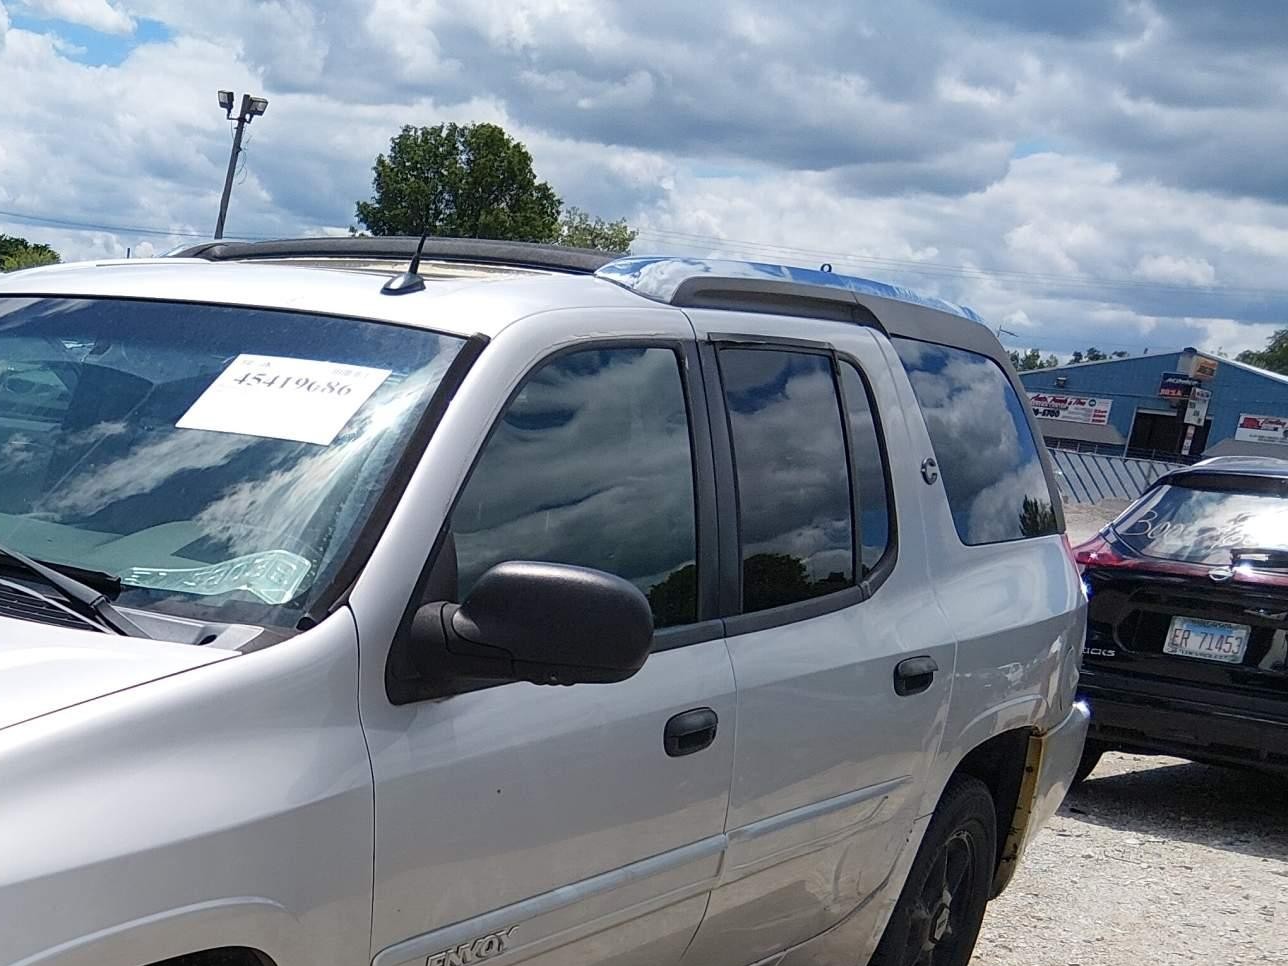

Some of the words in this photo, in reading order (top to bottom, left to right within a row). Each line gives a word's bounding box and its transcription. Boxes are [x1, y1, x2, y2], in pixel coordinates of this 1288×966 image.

[234, 372, 352, 396] 45419686
[1172, 628, 1192, 648] ER
[1199, 631, 1243, 655] 71453
